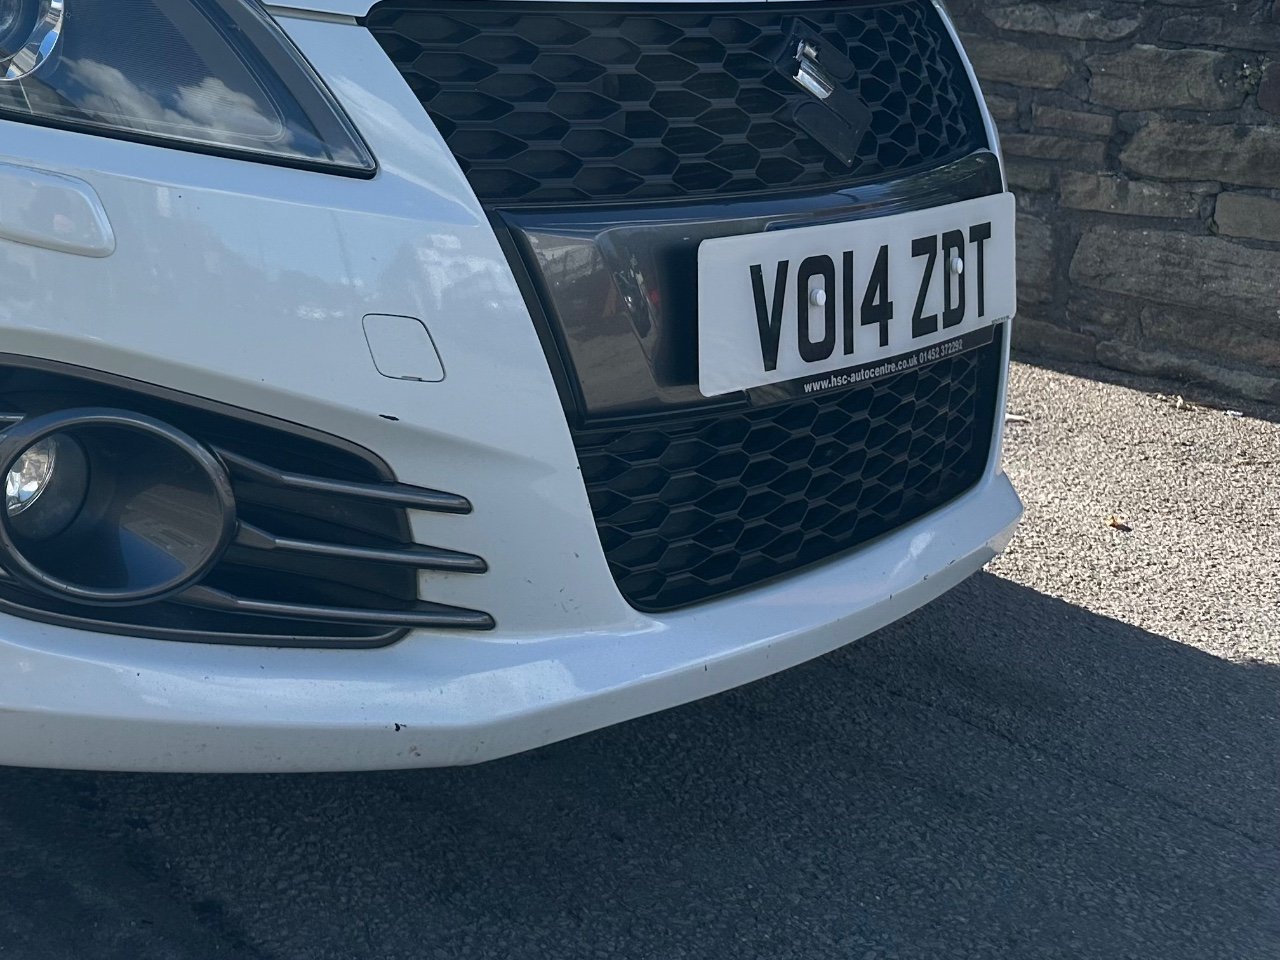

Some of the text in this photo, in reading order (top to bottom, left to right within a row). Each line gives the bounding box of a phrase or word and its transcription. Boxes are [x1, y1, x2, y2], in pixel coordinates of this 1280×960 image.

[749, 221, 992, 372] VO14 ZDT
[804, 355, 918, 392] www.hsc-autocentre.co.uk
[919, 347, 940, 363] 01452
